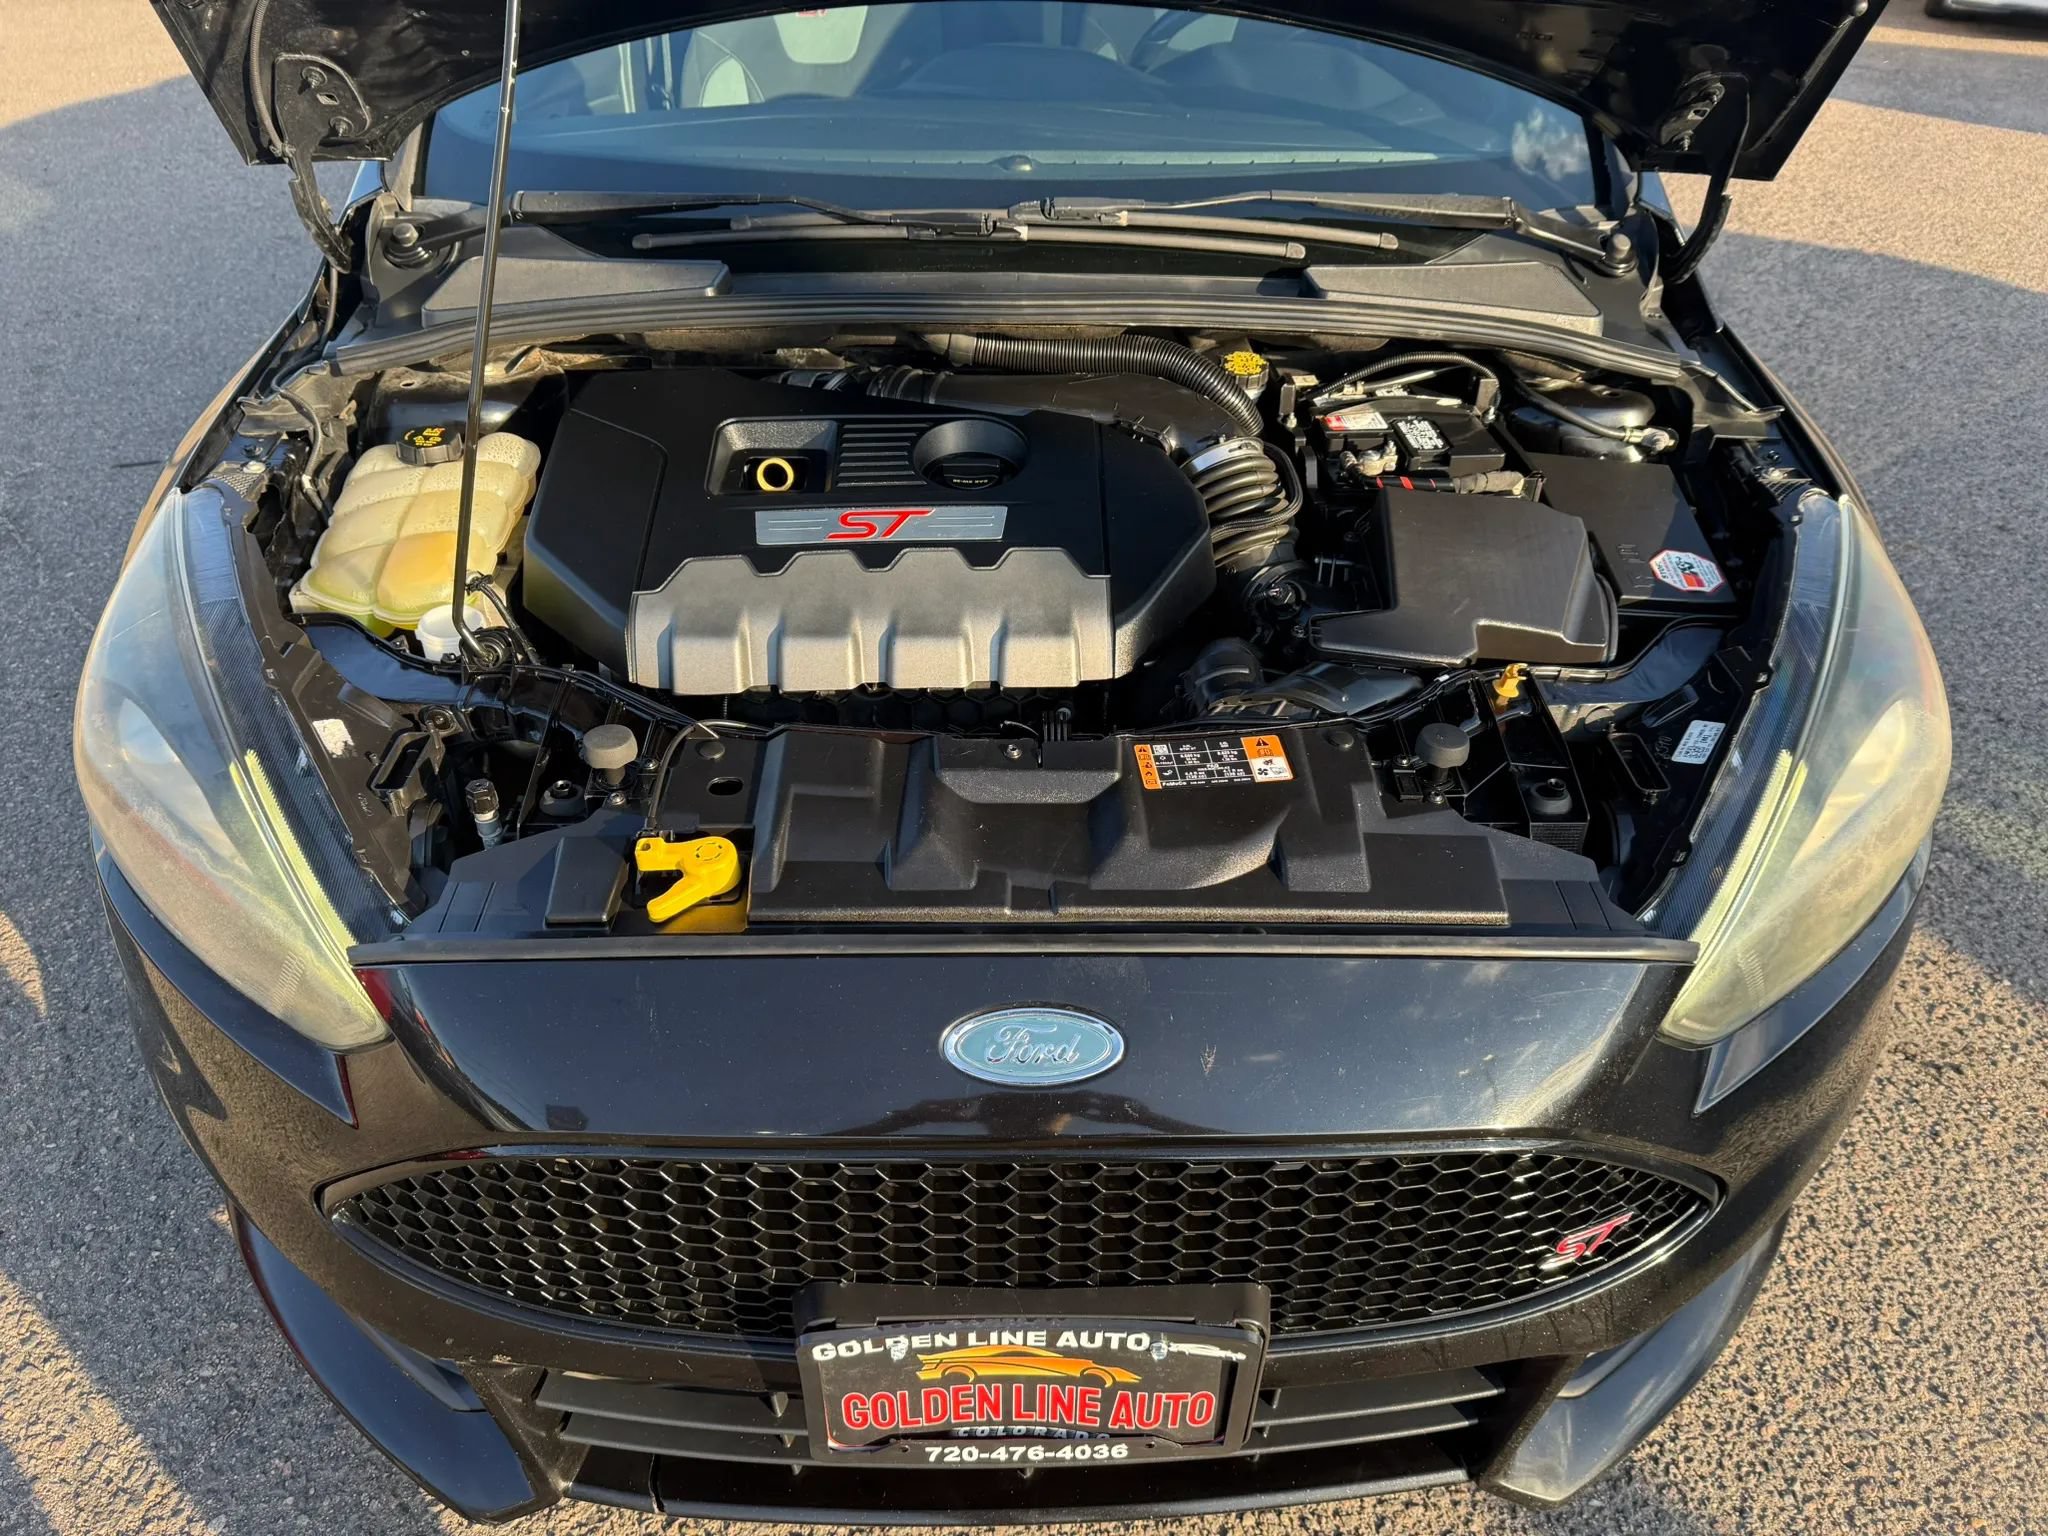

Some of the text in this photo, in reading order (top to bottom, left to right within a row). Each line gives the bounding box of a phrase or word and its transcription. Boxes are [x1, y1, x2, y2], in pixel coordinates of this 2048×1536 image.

[824, 507, 936, 541] ST
[986, 1023, 1082, 1065] Ford
[1539, 1211, 1634, 1270] ST
[812, 1330, 1151, 1362] GOLDEN LINE AUTO
[841, 1383, 1216, 1431] GOLDEN LINE AUTO
[925, 1443, 1129, 1463] 720-476-4036
